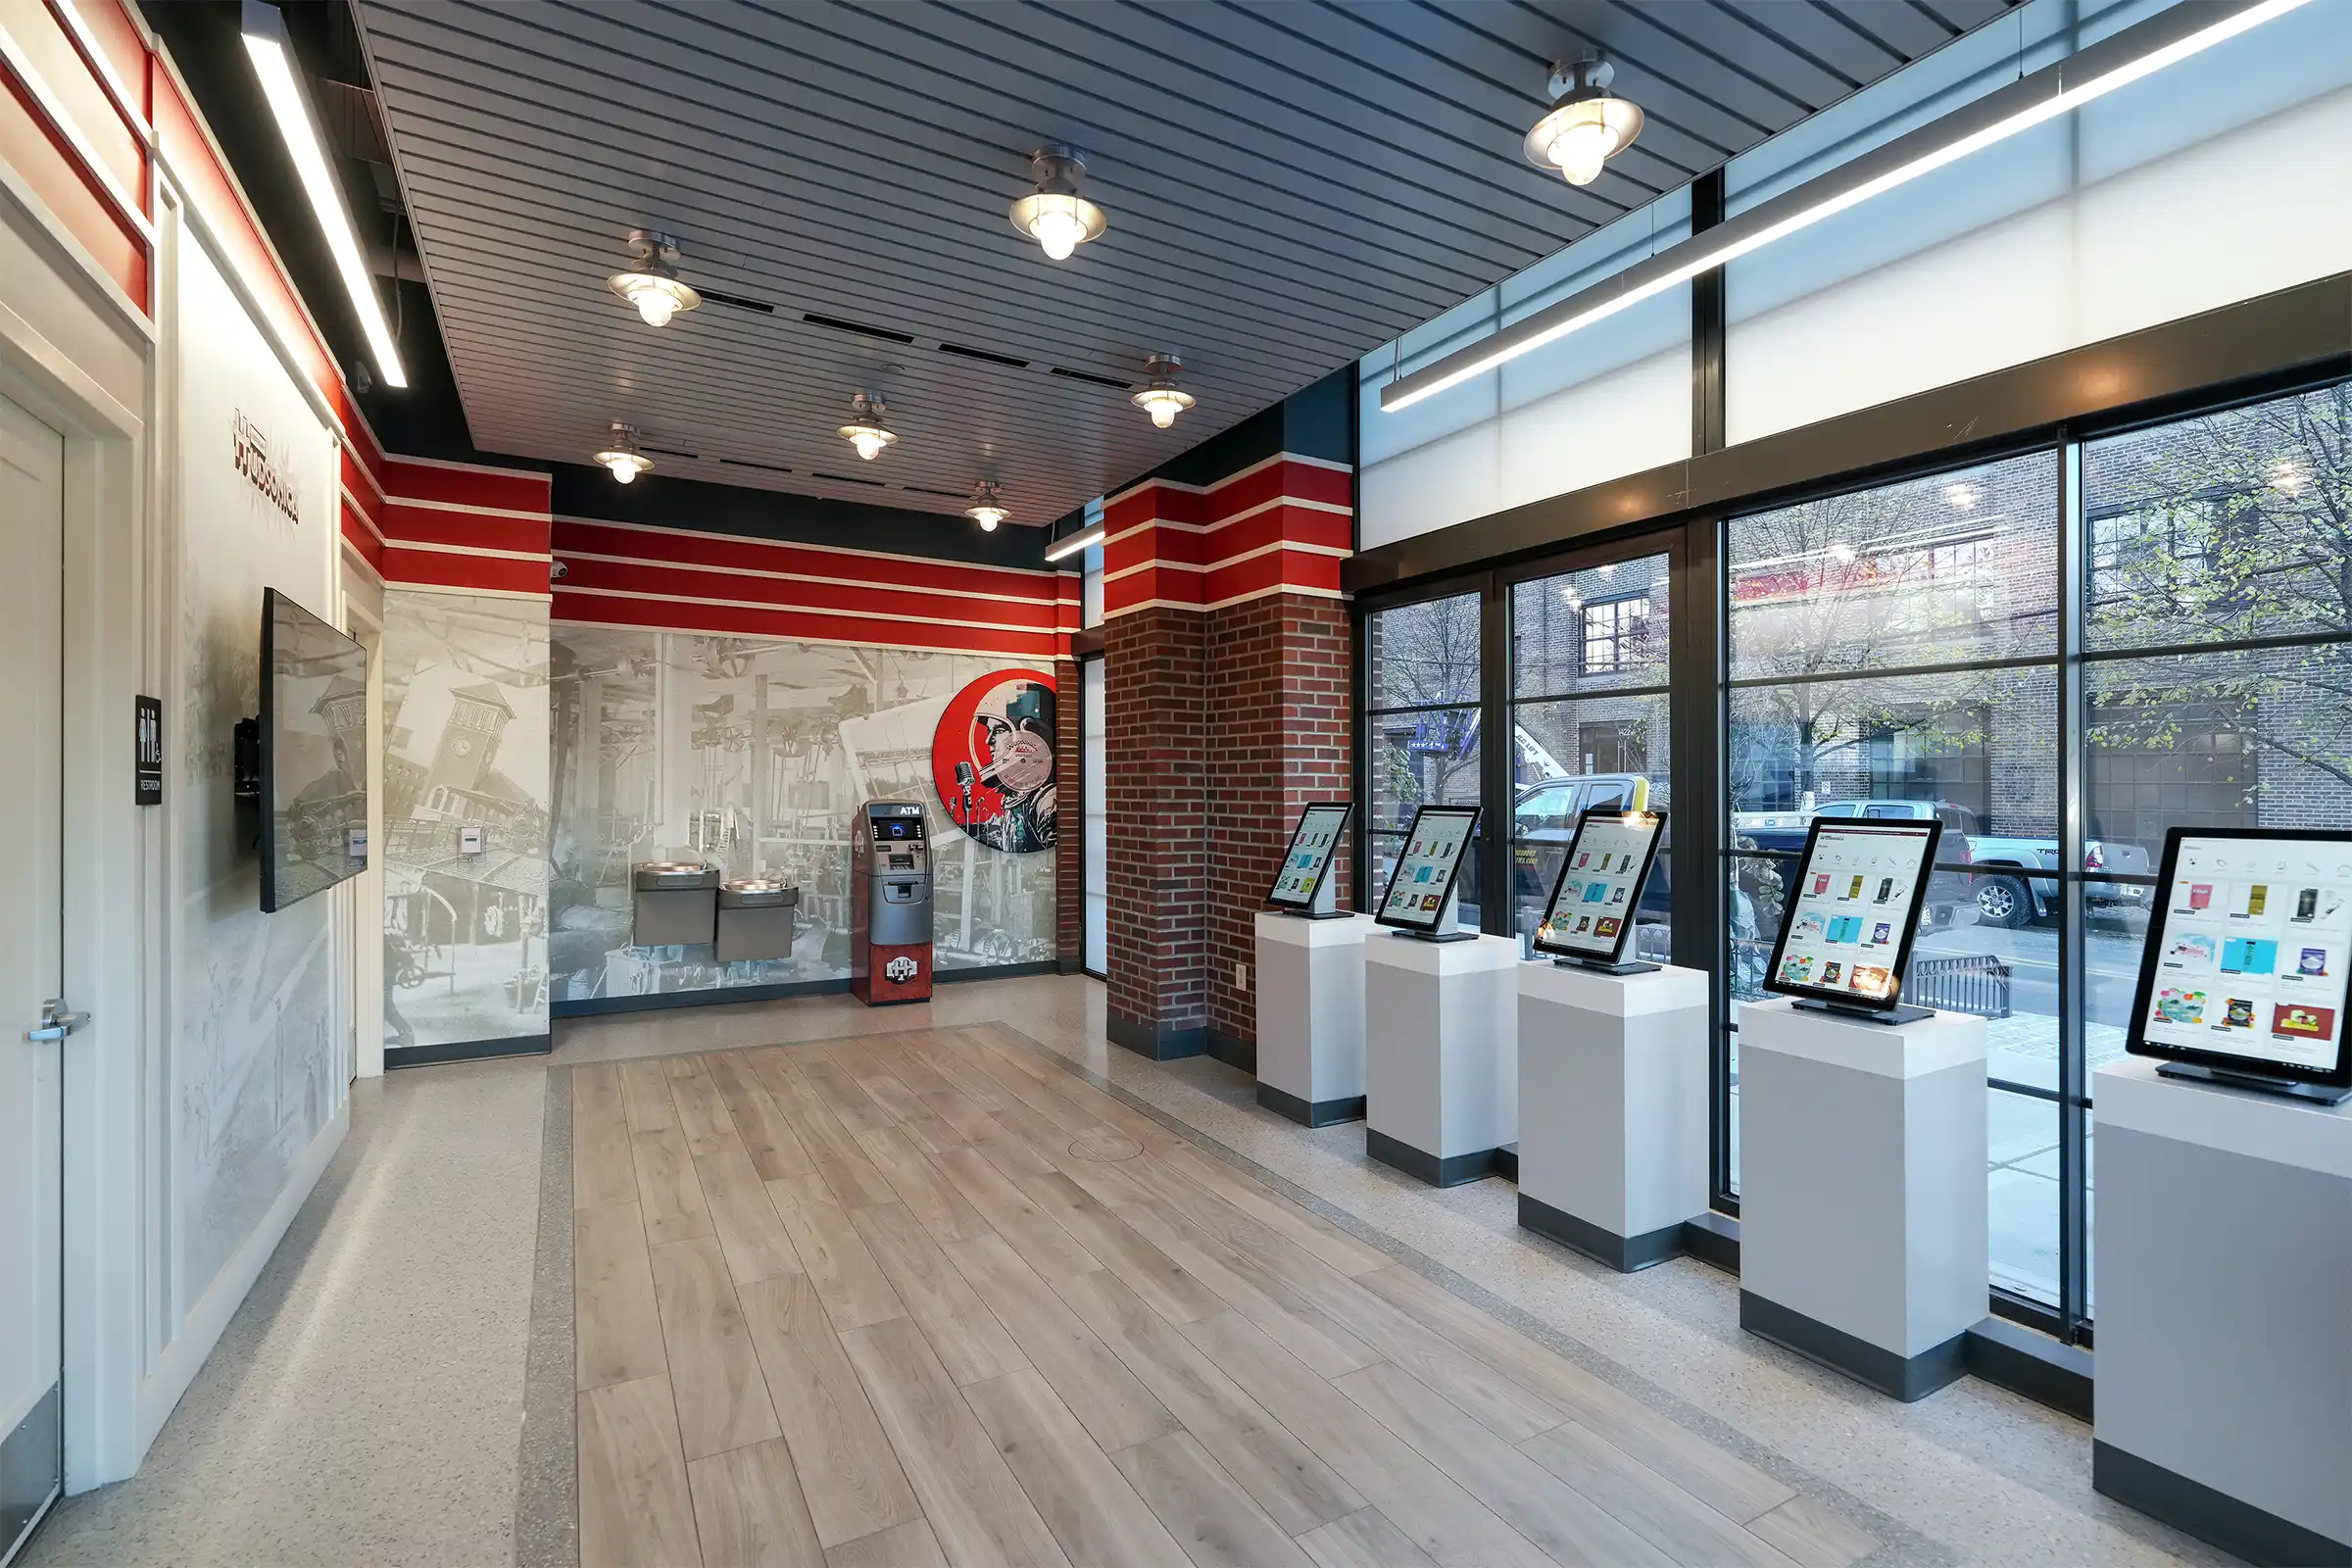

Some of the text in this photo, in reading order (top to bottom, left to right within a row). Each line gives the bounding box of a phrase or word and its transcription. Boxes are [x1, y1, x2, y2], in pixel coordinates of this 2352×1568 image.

[1525, 743, 1540, 756] LIFT
[140, 779, 161, 791] RESTROOM
[900, 807, 920, 815] ATM
